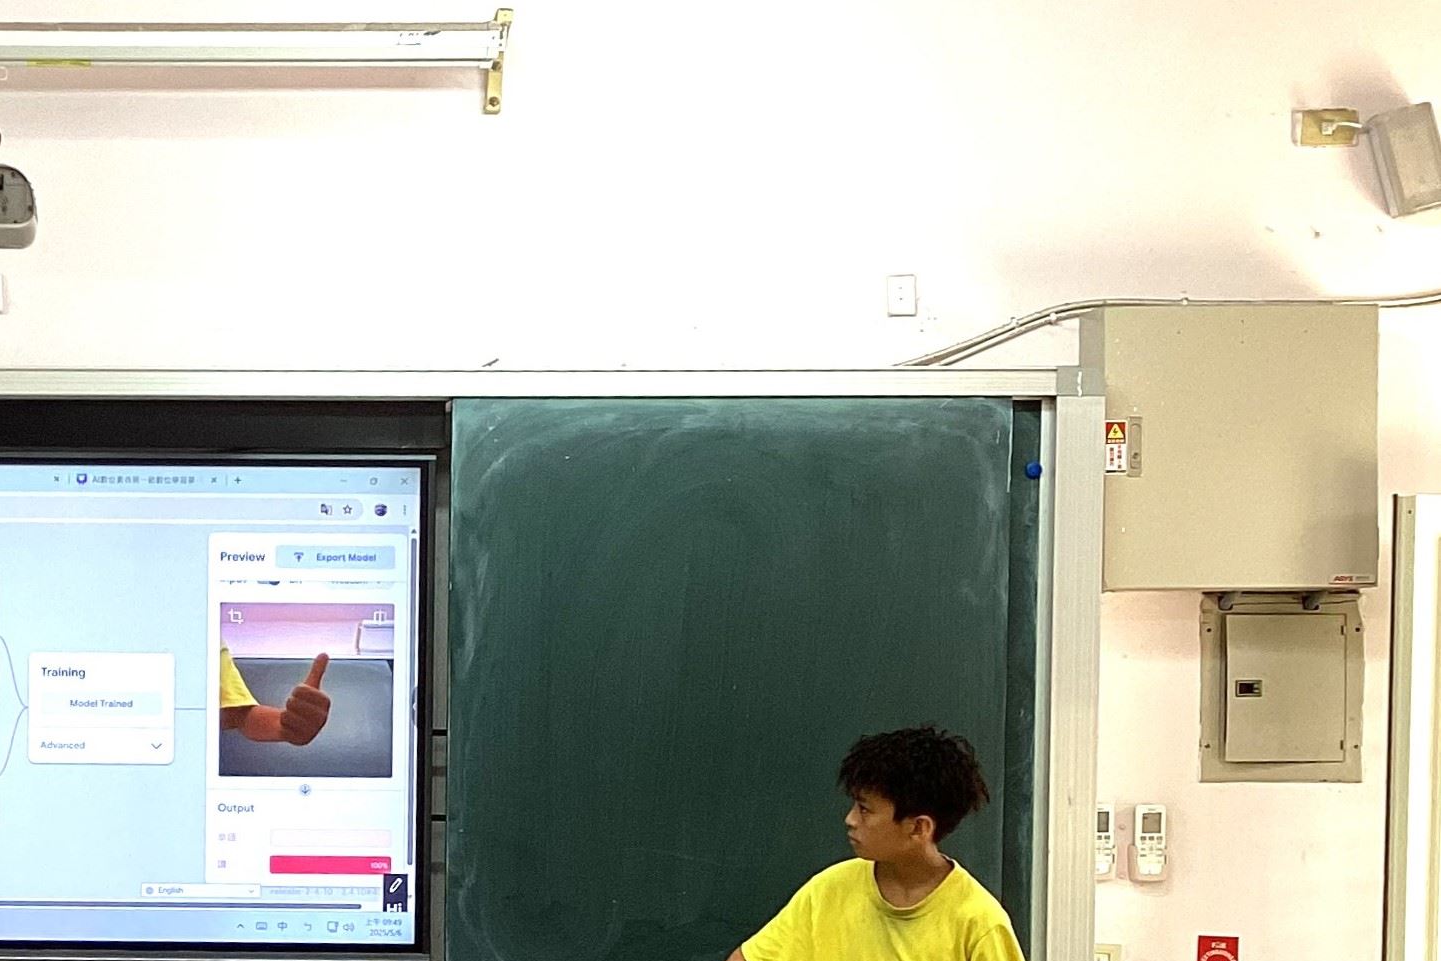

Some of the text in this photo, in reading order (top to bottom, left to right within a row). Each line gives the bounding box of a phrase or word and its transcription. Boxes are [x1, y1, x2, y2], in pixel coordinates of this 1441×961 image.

[220, 551, 266, 563] Preview
[316, 552, 377, 564] Export Model
[41, 667, 86, 680] Training
[69, 699, 134, 708] Model Trained
[40, 740, 86, 750] Advanced
[217, 802, 255, 815] Output
[158, 886, 184, 896] English
